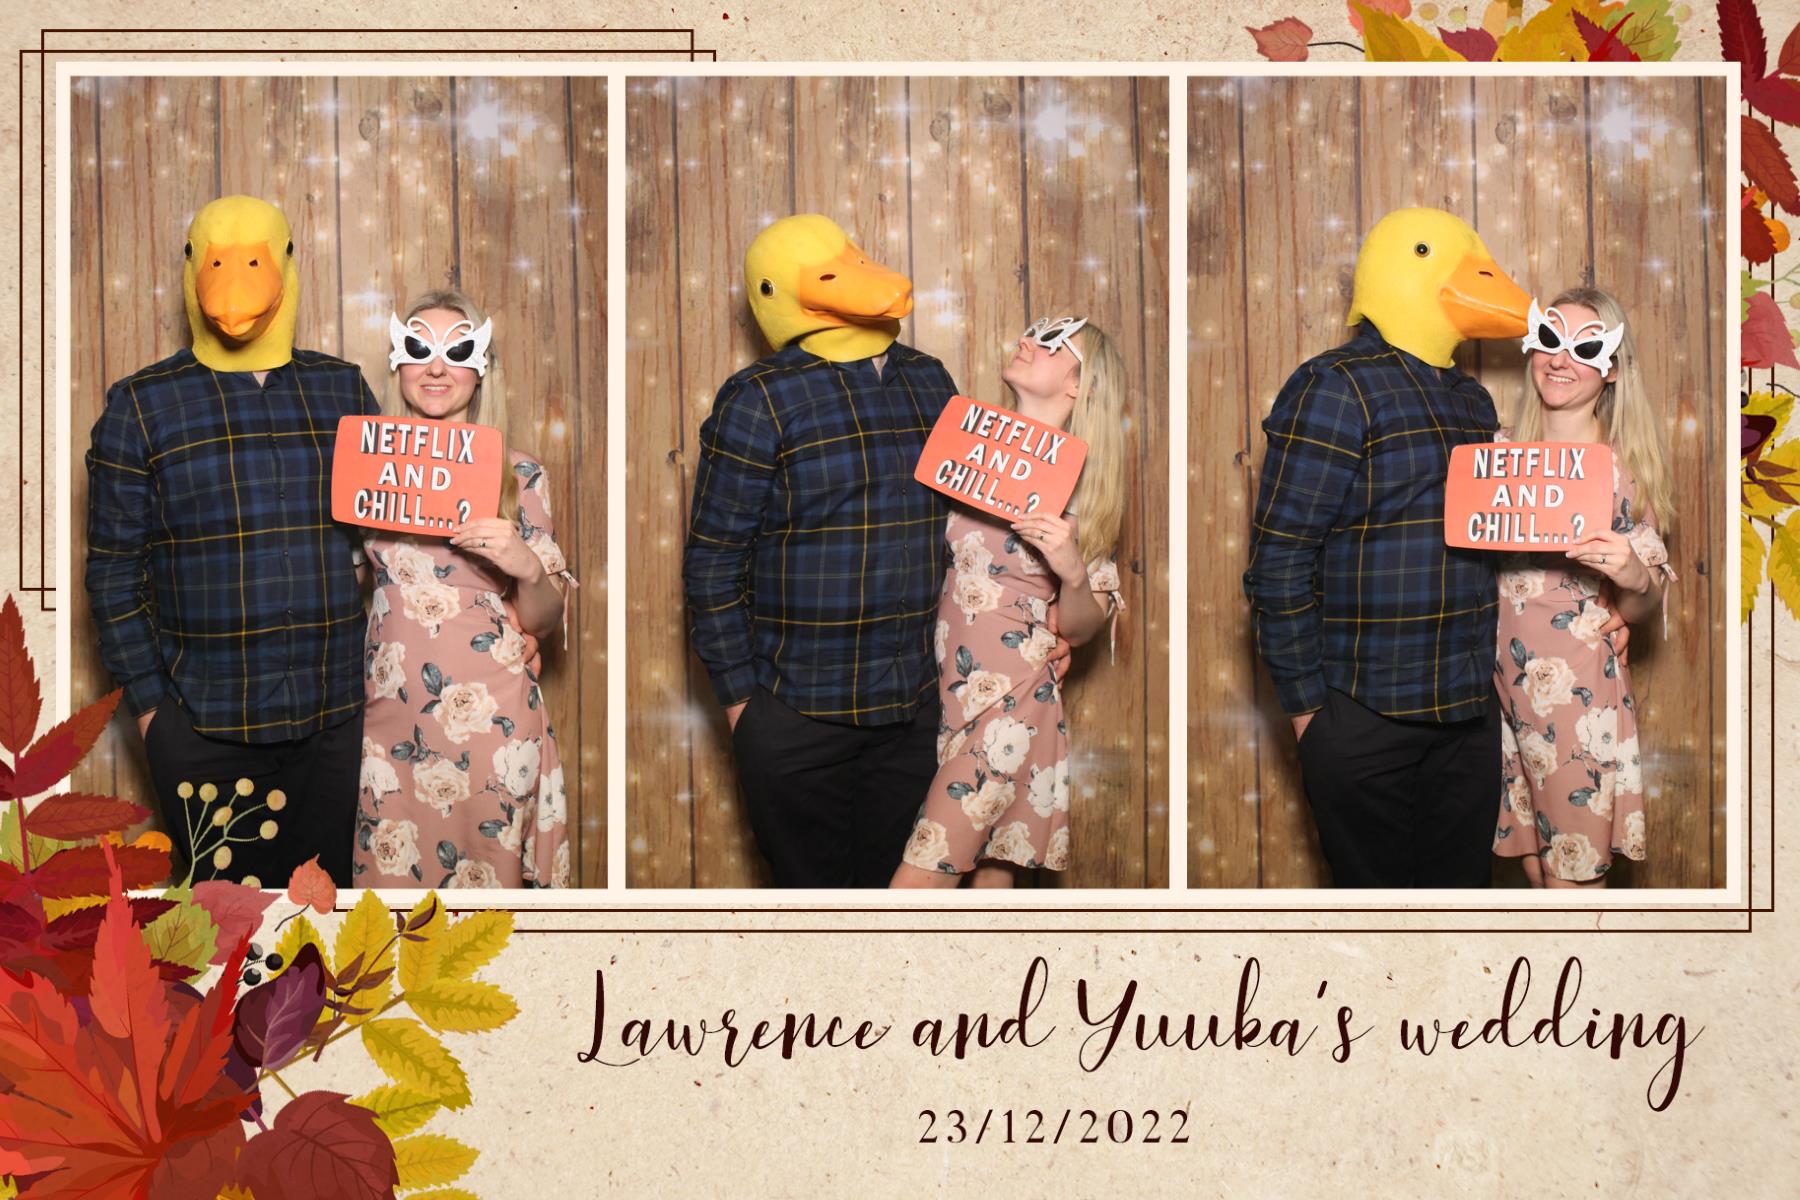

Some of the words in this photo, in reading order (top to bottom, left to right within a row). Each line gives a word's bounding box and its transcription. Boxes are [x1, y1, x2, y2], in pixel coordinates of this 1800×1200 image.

[360, 420, 476, 464] NETFLIX
[960, 403, 1067, 465] NETFLIX
[378, 461, 452, 491] AND
[965, 442, 1032, 481] AND
[1473, 447, 1586, 480] NETFLIX
[1491, 484, 1565, 508] AND
